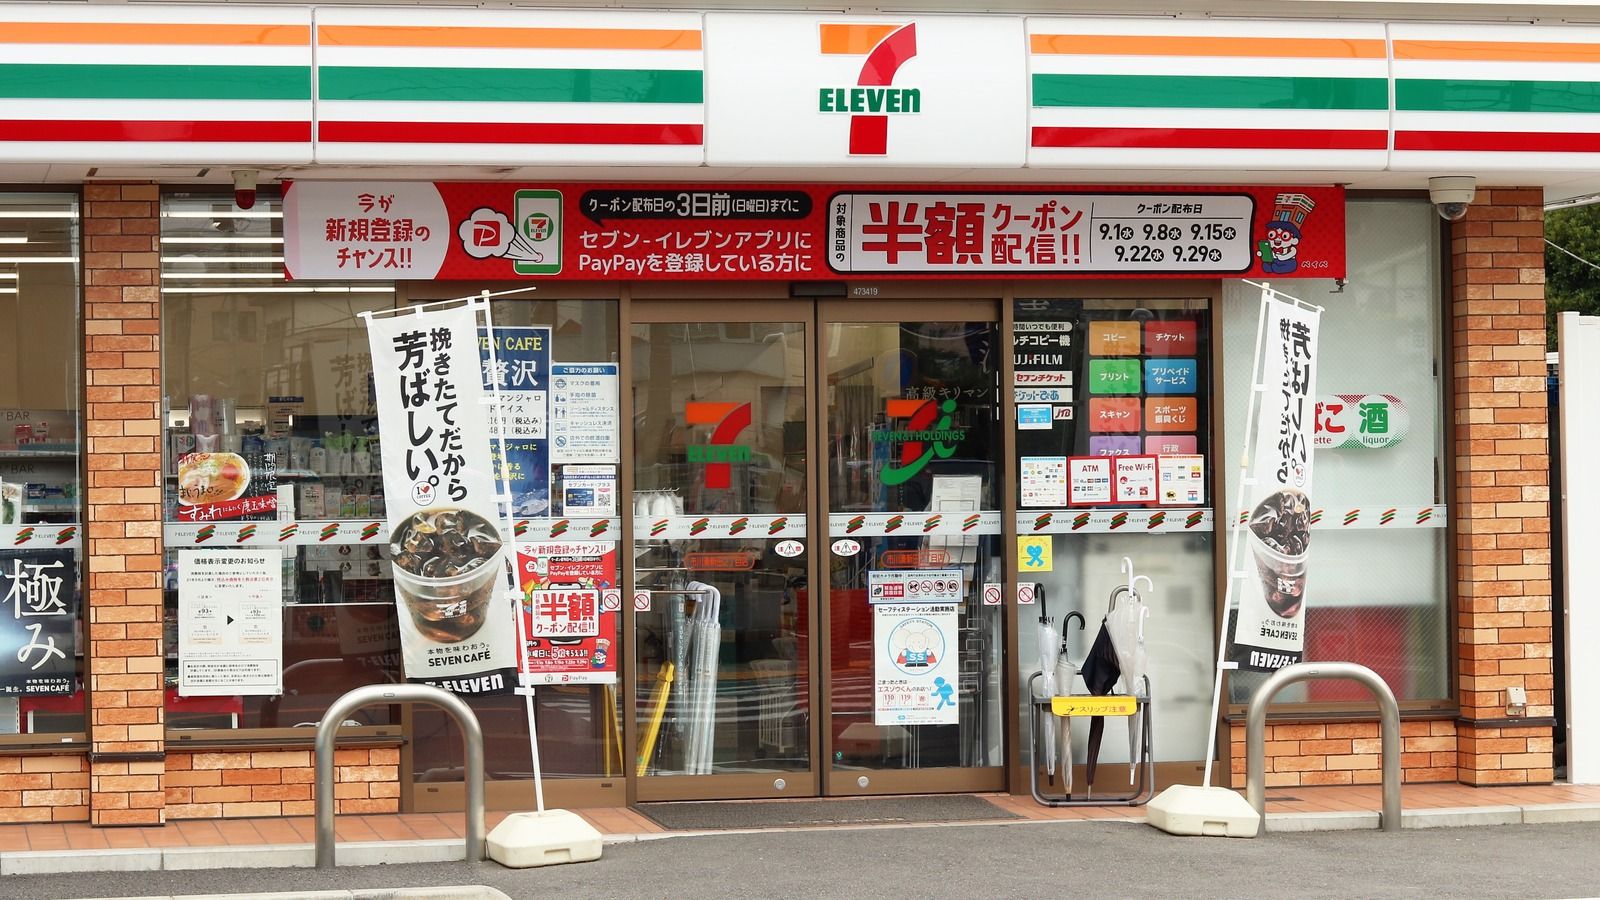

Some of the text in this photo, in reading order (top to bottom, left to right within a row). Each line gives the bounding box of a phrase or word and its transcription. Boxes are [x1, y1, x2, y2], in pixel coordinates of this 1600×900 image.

[819, 22, 917, 154] 7
[358, 193, 394, 213] 今が
[1137, 203, 1203, 214] クーポン配布日
[992, 200, 1083, 232] クーポン
[325, 217, 430, 242] 新規登録の
[835, 202, 847, 262] 対象商品の
[862, 201, 985, 264] 半額
[991, 234, 1080, 264] 配信!!
[336, 247, 412, 268] チャンス!!
[579, 252, 812, 275] PayPayを登録している方に
[853, 287, 878, 296] 473419
[1103, 333, 1127, 341] コピー
[1155, 333, 1185, 341] チケット
[505, 336, 543, 351] CAFE
[1100, 373, 1129, 381] プリント
[1151, 367, 1190, 376] プリペイド
[1016, 373, 1066, 382] セブンチケット
[1155, 376, 1187, 385] サービス
[392, 330, 440, 487] 芳ばしい。
[430, 327, 468, 501] 挽きたてだから
[1055, 408, 1071, 418] JTB
[1100, 410, 1130, 418] スキャン
[1154, 405, 1187, 414] スポーツ
[6, 411, 30, 421] BAR
[1359, 402, 1388, 433] 酒
[915, 430, 965, 441] HOLDINGS
[1362, 436, 1390, 445] liquor
[685, 402, 752, 489] 7
[1162, 444, 1179, 453] 行政
[10, 463, 34, 474] BAR
[1081, 464, 1099, 472] ATM
[1118, 463, 1154, 471] Free Wi-Fi
[541, 592, 594, 621] 半額
[4, 558, 67, 670] 極み
[427, 643, 490, 655] 本物を味わおう。
[428, 648, 491, 667] SEVEN CAFÉ
[910, 653, 925, 661] SS
